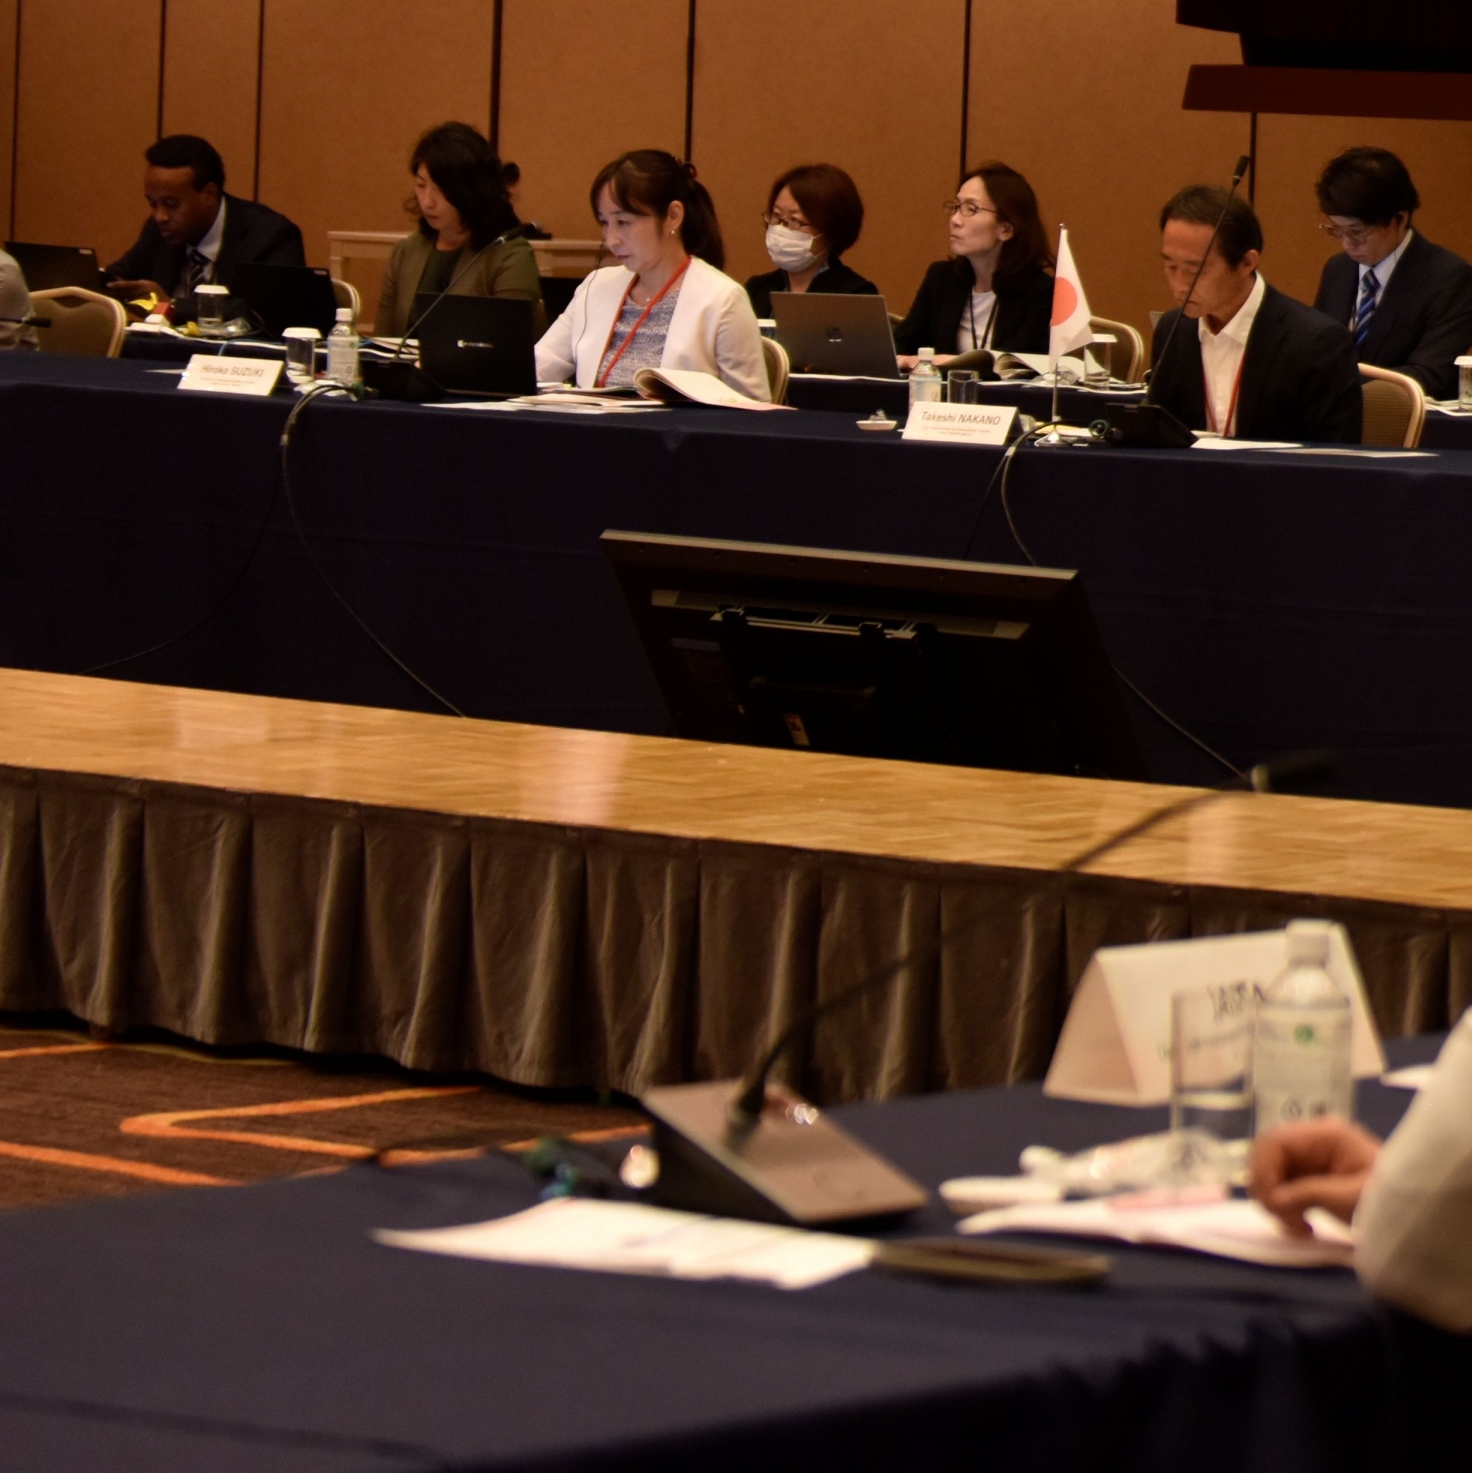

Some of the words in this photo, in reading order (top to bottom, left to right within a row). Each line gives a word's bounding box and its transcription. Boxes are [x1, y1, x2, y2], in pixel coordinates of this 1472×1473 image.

[230, 366, 265, 377] SUZUKI
[921, 411, 957, 423] Takeshi
[958, 414, 1001, 425] NAKANO
